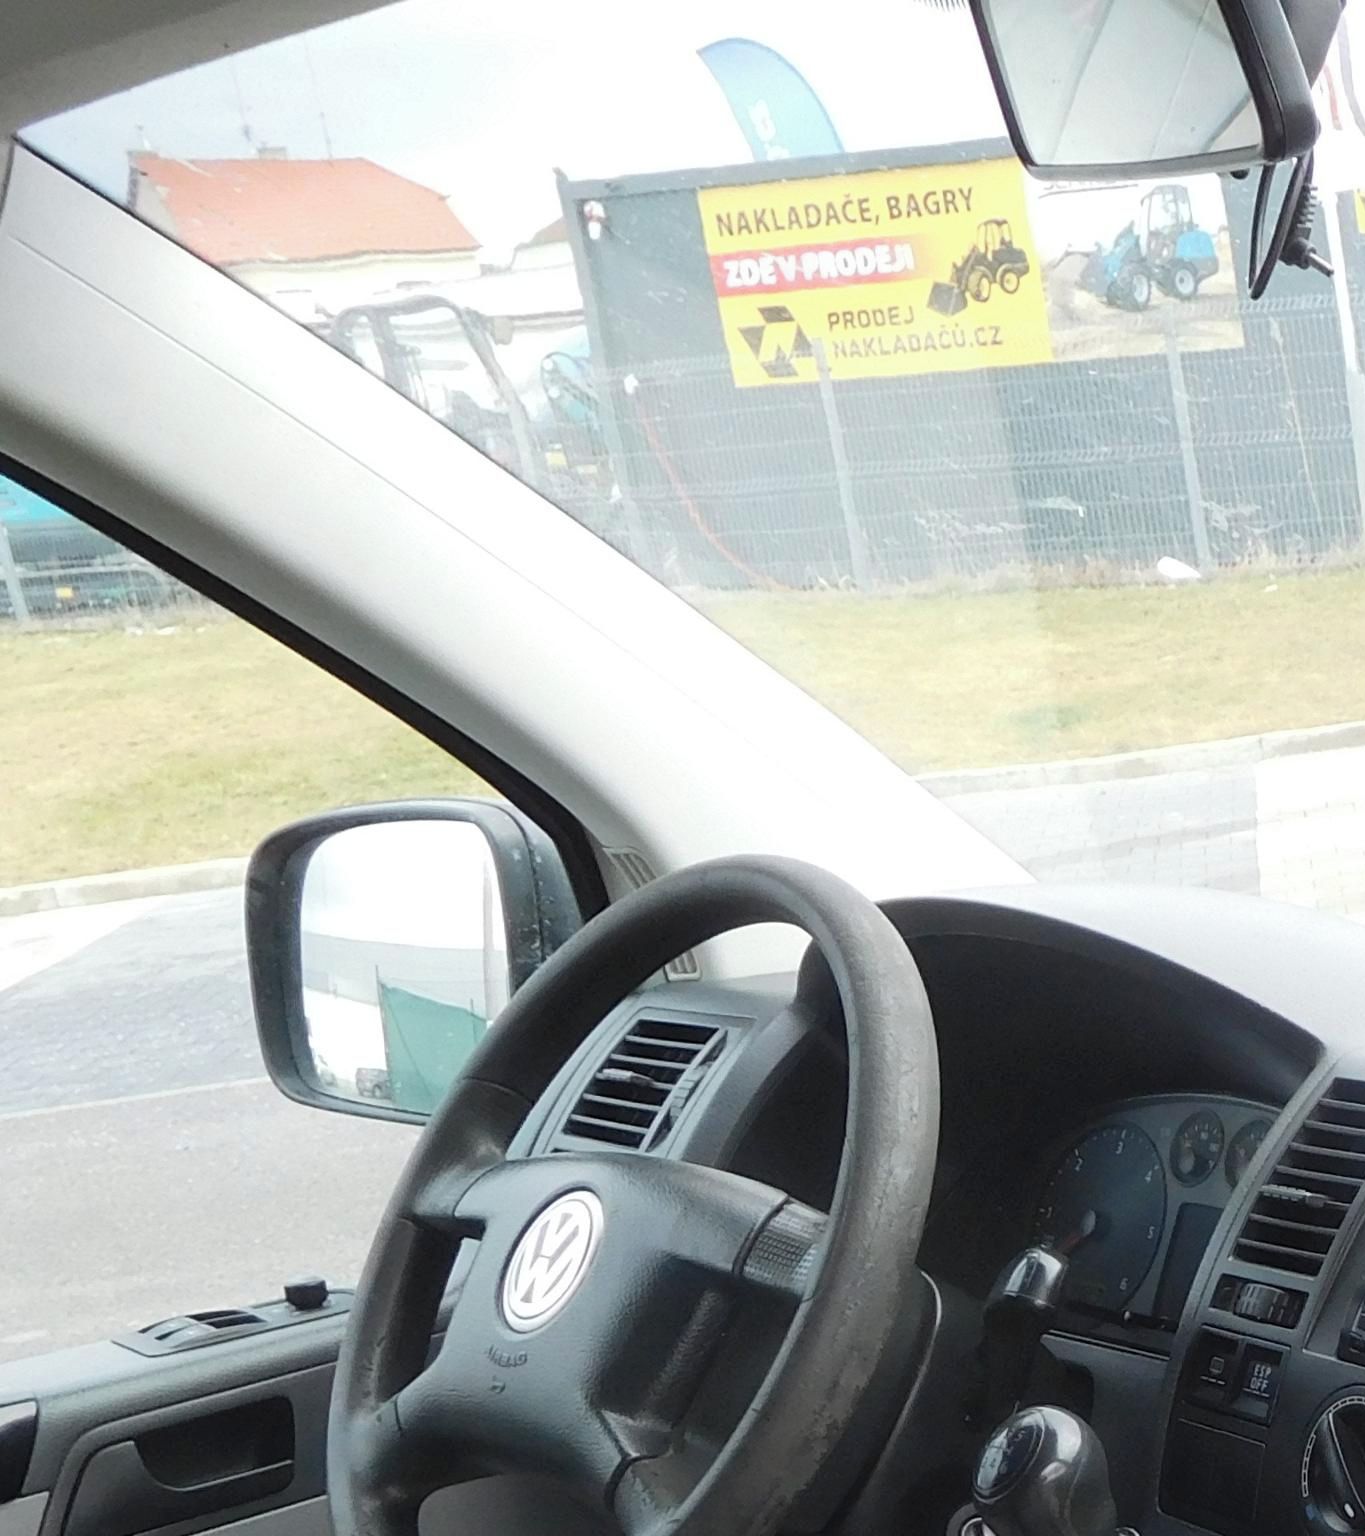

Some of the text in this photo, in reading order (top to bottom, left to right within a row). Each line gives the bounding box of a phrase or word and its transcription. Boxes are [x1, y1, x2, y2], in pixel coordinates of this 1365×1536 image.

[716, 187, 974, 237] NAKLADAČE, BAGRY
[774, 254, 797, 282] V
[802, 243, 916, 281] PRODEJI
[827, 306, 915, 332] PRODEJ
[1115, 1141, 1124, 1155] 3
[1075, 1158, 1083, 1171] 2
[1254, 1364, 1272, 1379] ESP
[1250, 1377, 1269, 1392] OFF
